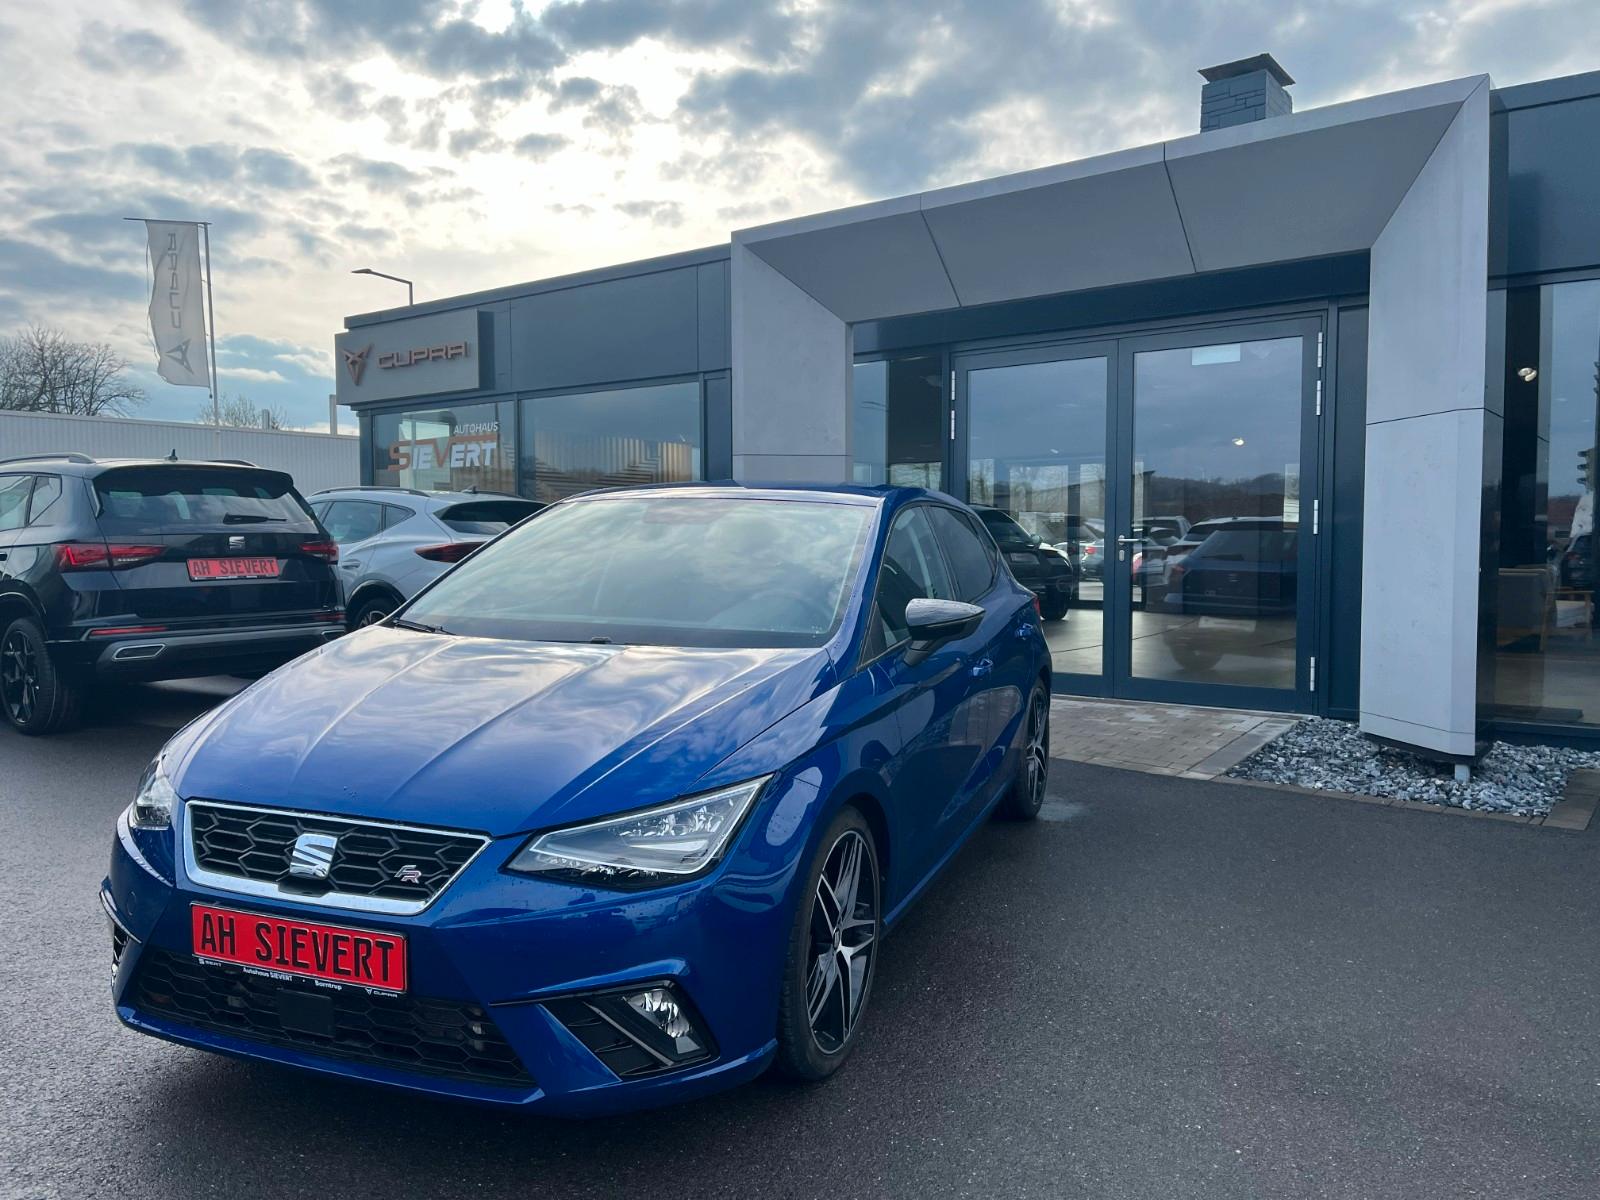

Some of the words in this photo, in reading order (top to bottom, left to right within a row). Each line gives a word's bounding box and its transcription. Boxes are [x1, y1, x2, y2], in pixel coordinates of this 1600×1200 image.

[376, 341, 470, 370] CUPRA
[453, 421, 499, 435] AUTOHAUS
[387, 434, 498, 473] SIEVERT
[192, 560, 210, 576] AH
[219, 558, 276, 575] SIEVERT
[393, 864, 422, 884] FR
[201, 911, 236, 957] AH
[255, 921, 395, 983] SIEVERT
[269, 971, 293, 982] SIEVERT
